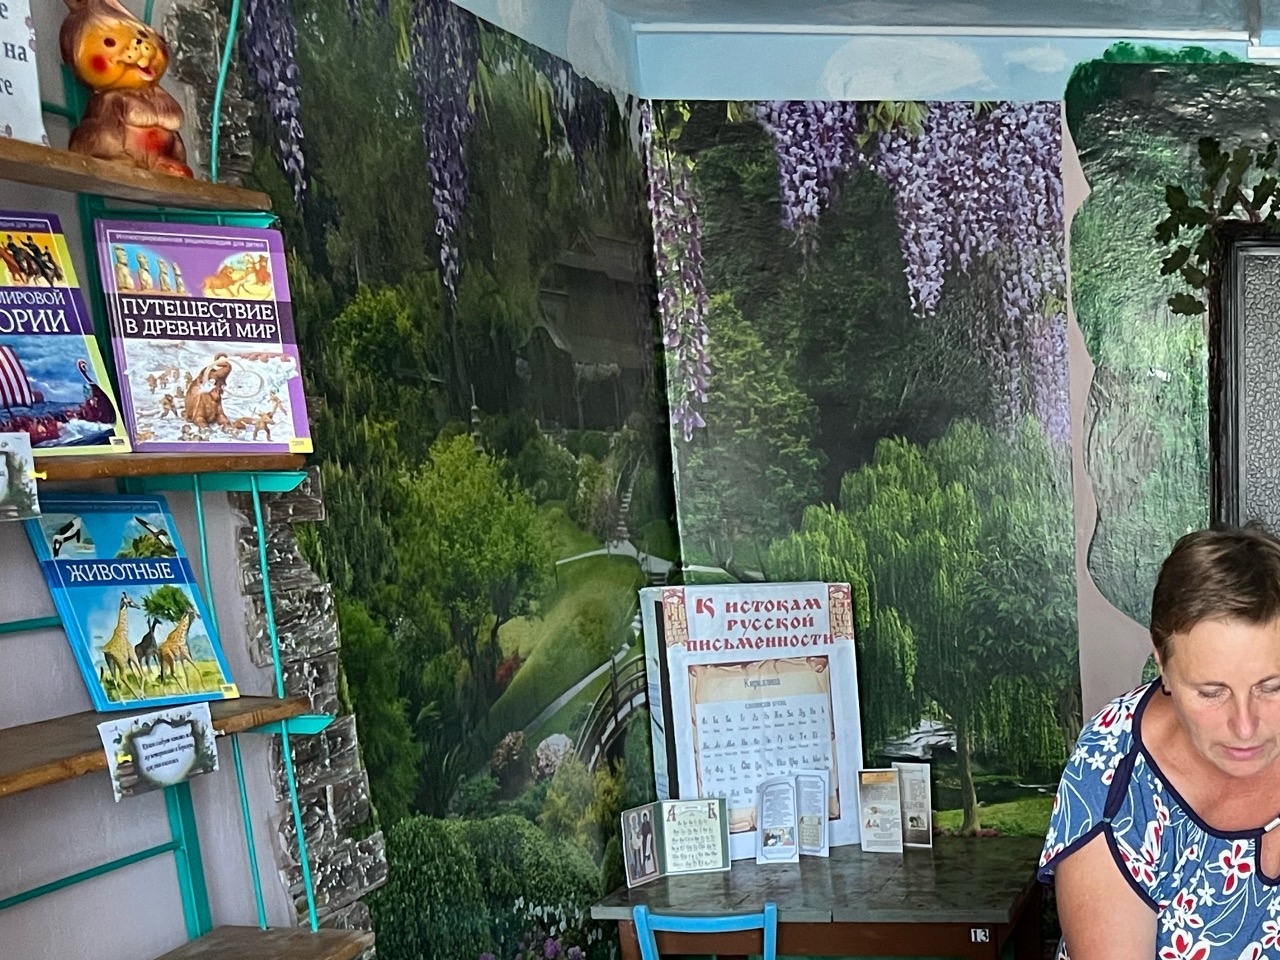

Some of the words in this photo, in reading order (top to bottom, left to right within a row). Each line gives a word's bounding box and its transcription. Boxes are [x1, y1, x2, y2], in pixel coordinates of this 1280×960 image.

[3, 41, 28, 62] на
[122, 298, 275, 321] ПУТЕШЕСТВИЕ
[125, 318, 139, 334] В
[142, 317, 232, 337] ДРЕВНИЙ
[235, 323, 276, 339] МИР
[66, 562, 176, 583] ЖИВОТНЫЕ
[695, 597, 715, 619] К
[972, 929, 989, 942] 13
